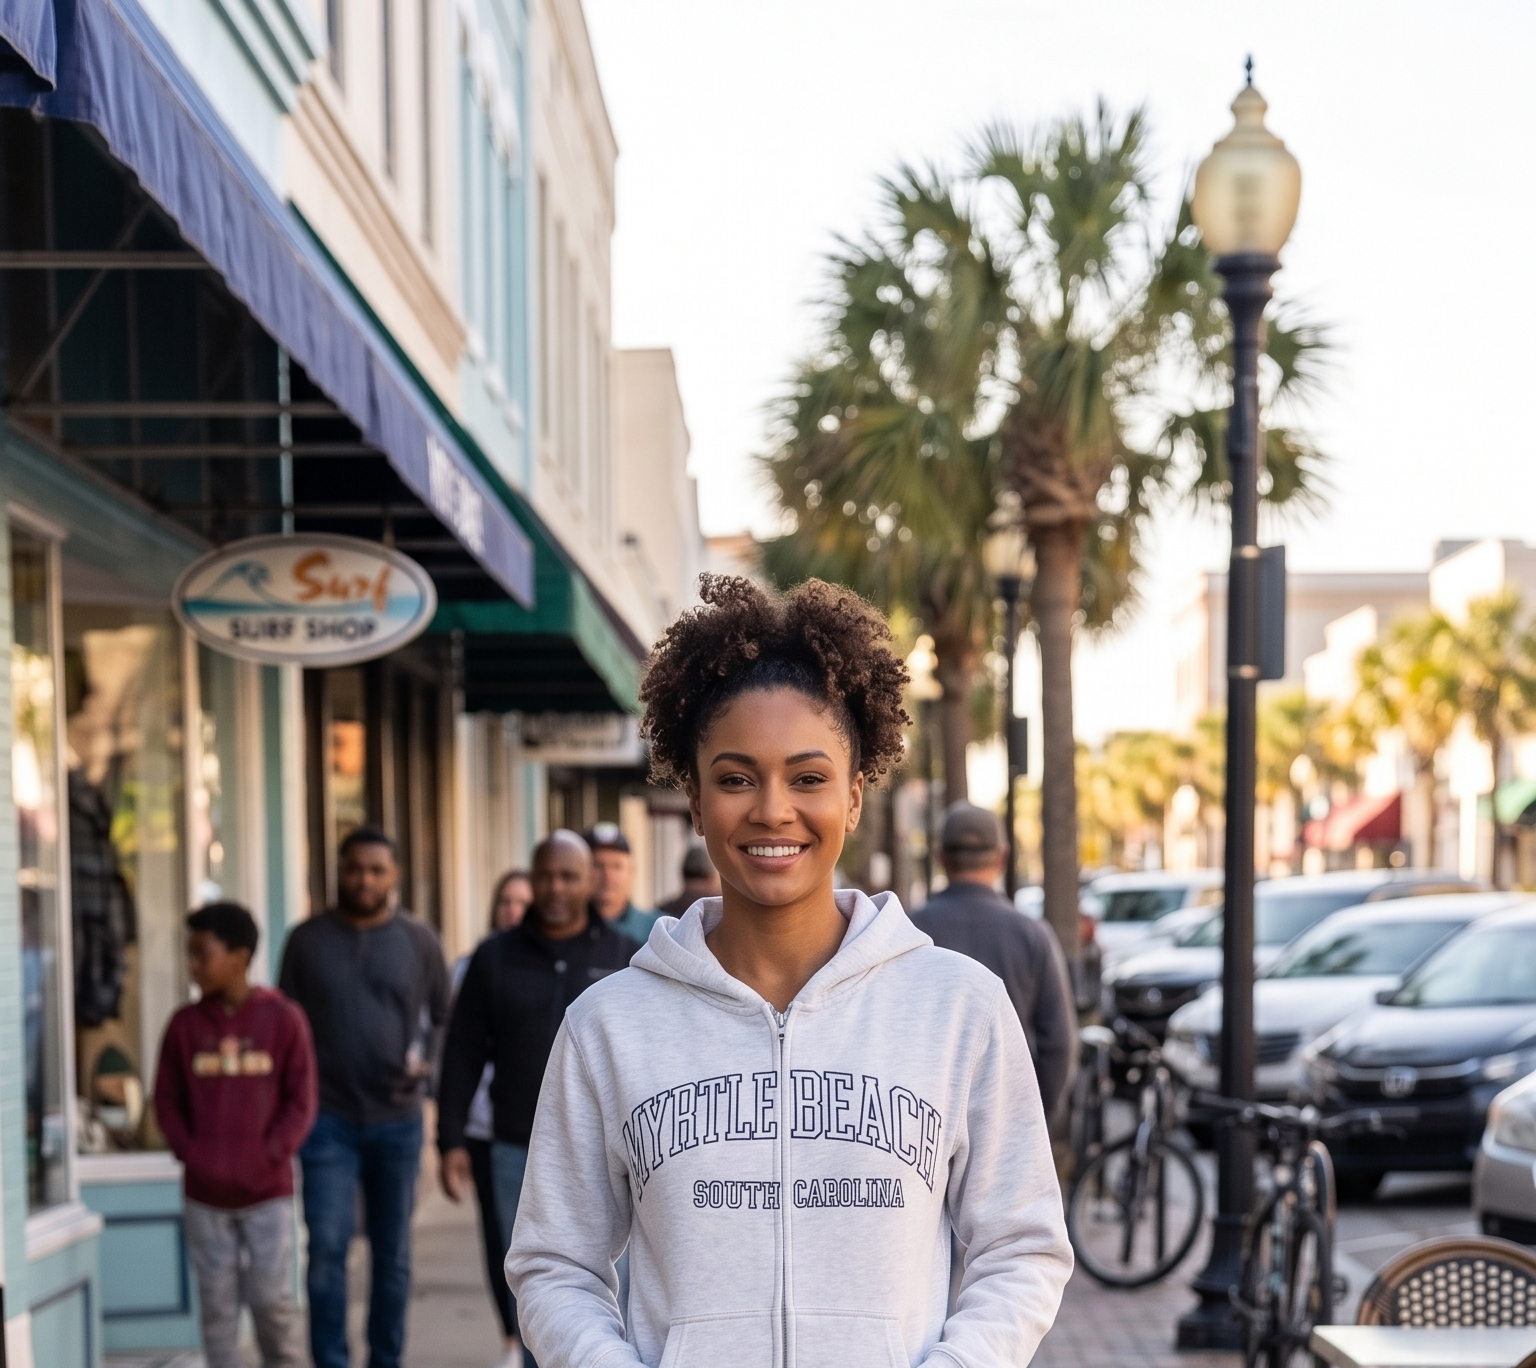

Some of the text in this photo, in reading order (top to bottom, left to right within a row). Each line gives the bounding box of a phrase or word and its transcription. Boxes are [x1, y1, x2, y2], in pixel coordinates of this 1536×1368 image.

[293, 552, 392, 614] Surf
[230, 617, 378, 642] SURF SHOP
[622, 1069, 942, 1203] MYRTLE BEACH
[693, 1178, 905, 1209] SOUTH CAROLINA
